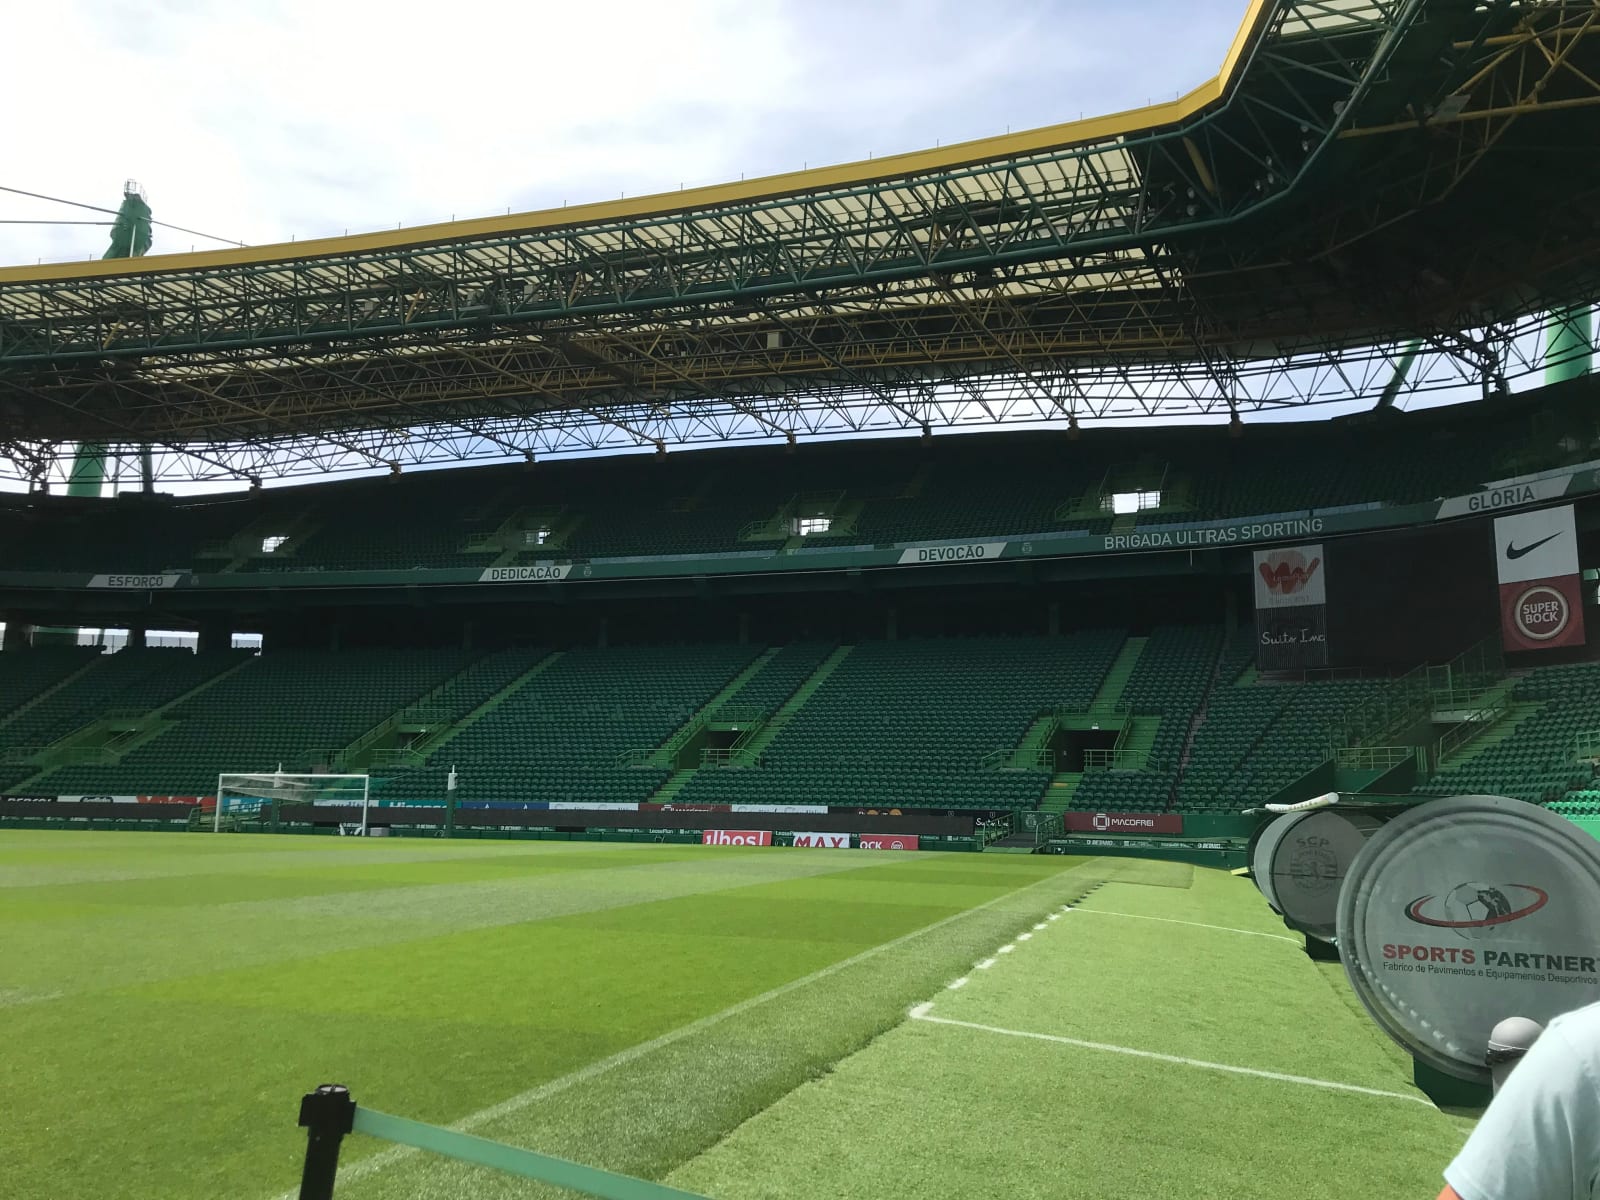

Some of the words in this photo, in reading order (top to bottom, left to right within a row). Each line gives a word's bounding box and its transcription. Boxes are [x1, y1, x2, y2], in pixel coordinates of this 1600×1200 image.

[1104, 532, 1172, 550] BRIGADA
[1176, 527, 1237, 545] ULTRAS
[1240, 518, 1323, 539] SPORTING
[1522, 601, 1559, 615] SUPER
[1525, 612, 1559, 625] BOCK
[1383, 943, 1476, 964] SPORTS
[1383, 962, 1414, 972] Fabrico
[1415, 963, 1426, 973] de
[1428, 964, 1476, 977] Pavimentos
[1486, 968, 1546, 982] Equipamentos
[1547, 973, 1598, 985] Desportivos
